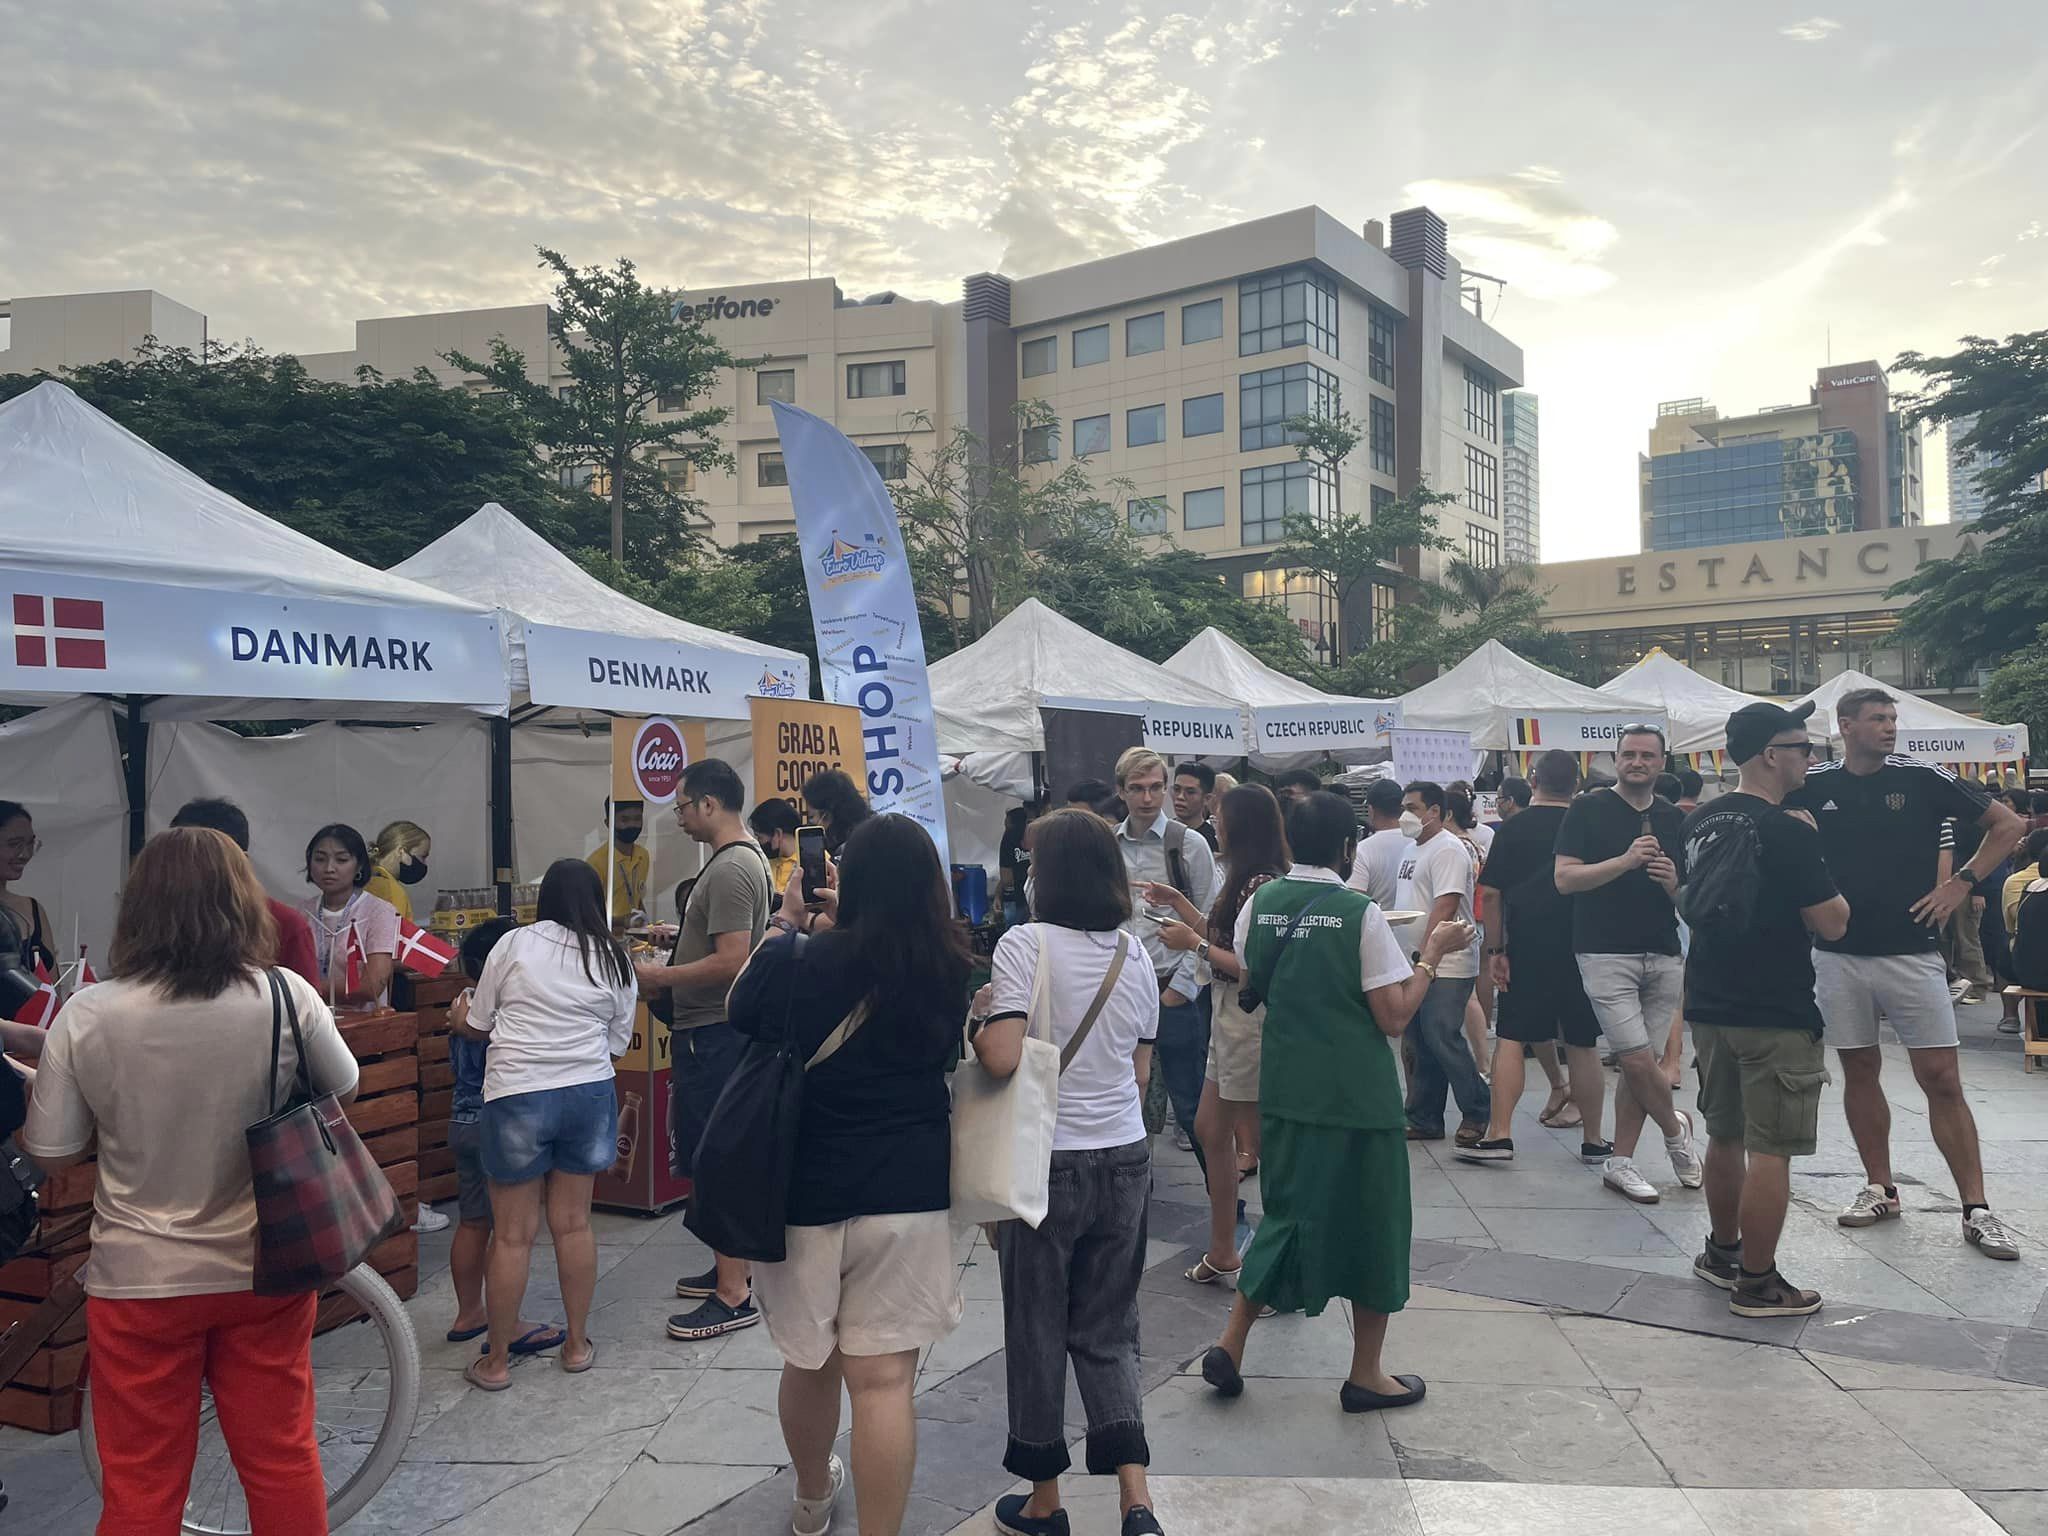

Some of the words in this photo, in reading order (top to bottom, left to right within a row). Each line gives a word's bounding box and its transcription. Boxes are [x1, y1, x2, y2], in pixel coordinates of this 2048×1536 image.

[1831, 375, 1877, 387] ValuCare
[846, 550, 885, 571] Village
[231, 627, 433, 671] DANMARK
[588, 657, 711, 694] DENMARK
[853, 645, 904, 796] SHOP
[1152, 720, 1234, 740] REPUBLIKA
[1266, 721, 1306, 737] CZECH
[1309, 719, 1365, 736] REPUBLIC
[778, 722, 825, 755] GRAB
[829, 726, 841, 756] A
[1908, 740, 1965, 752] BELGIUM
[639, 737, 681, 770] Cocio
[691, 1324, 726, 1337] crocs
